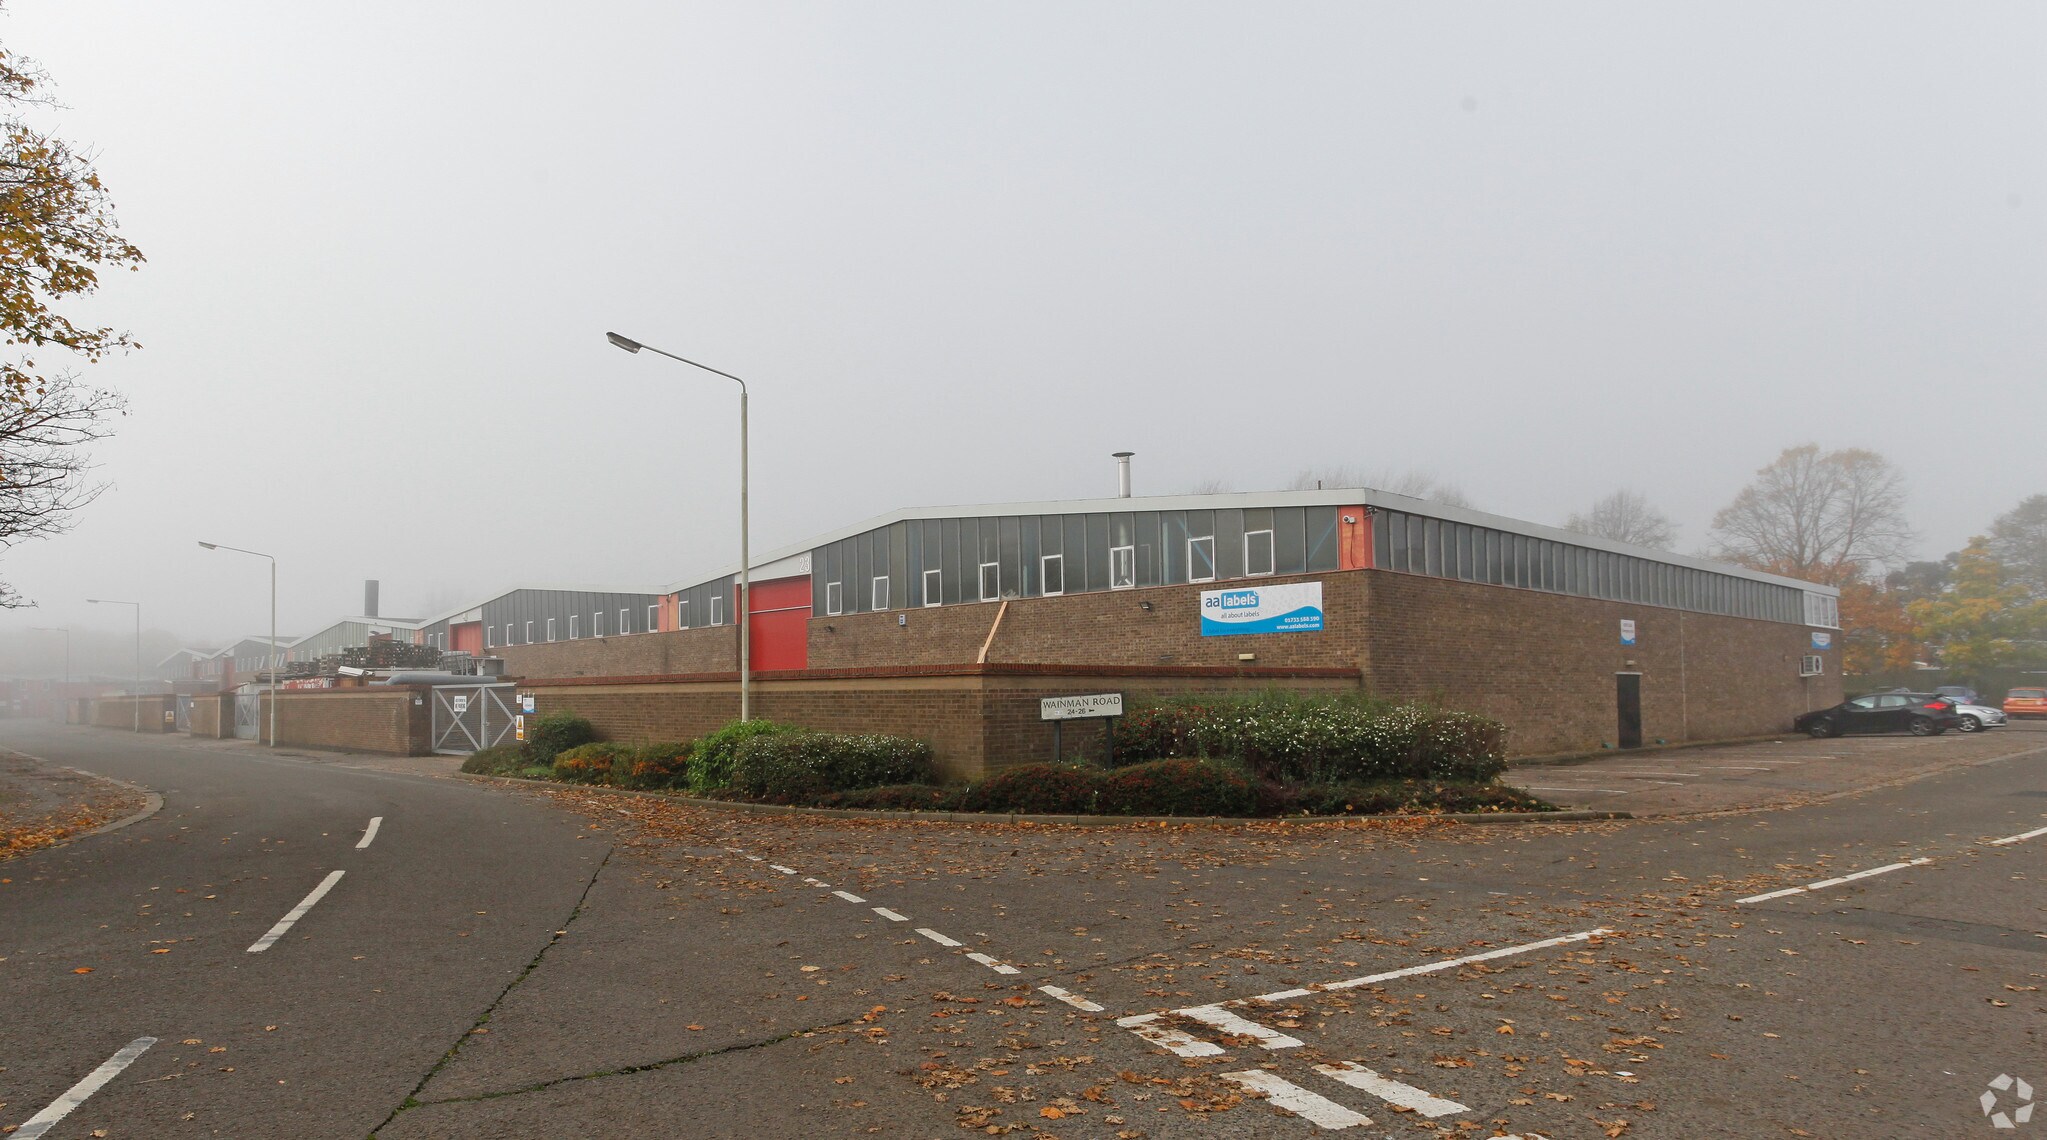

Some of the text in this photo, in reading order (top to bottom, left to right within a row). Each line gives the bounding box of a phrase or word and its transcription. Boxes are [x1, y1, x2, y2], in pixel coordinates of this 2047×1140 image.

[1206, 593, 1256, 607] aa labels
[1043, 697, 1120, 709] WAINMAN ROAD
